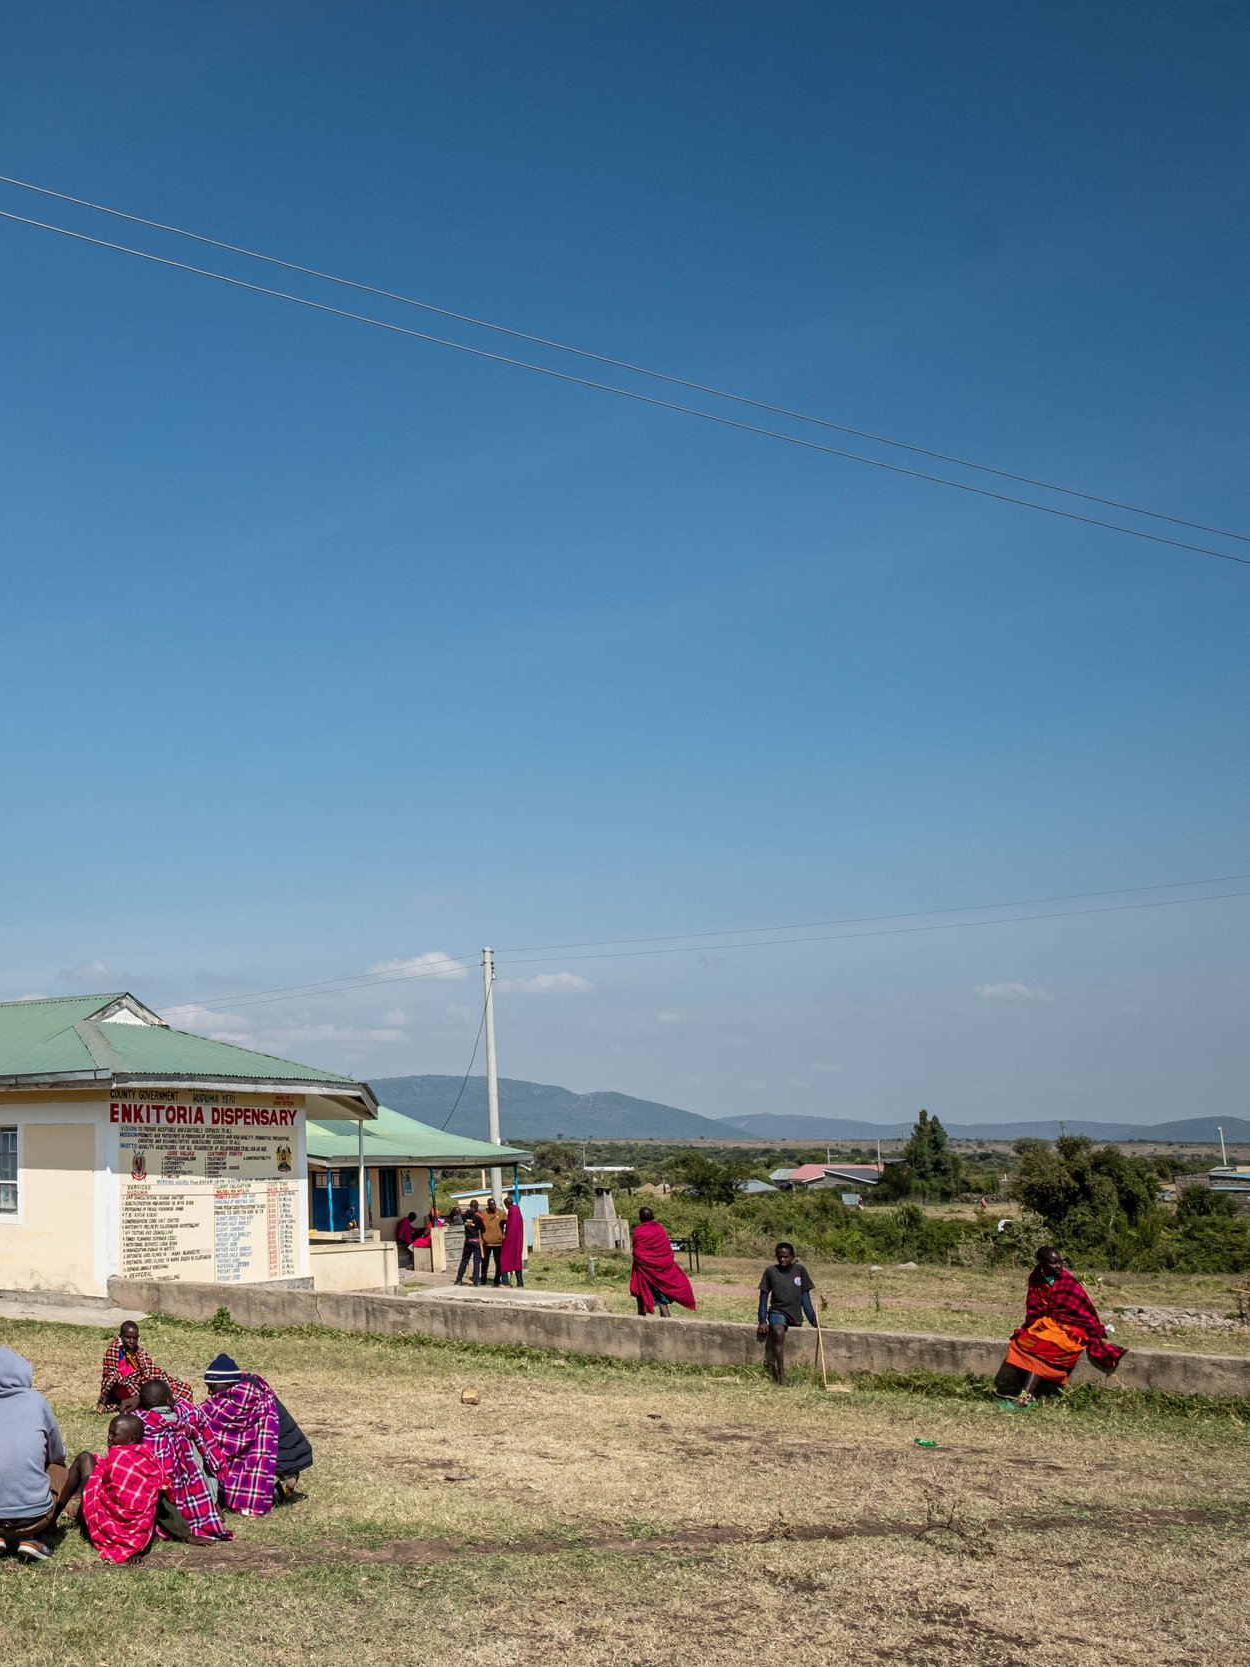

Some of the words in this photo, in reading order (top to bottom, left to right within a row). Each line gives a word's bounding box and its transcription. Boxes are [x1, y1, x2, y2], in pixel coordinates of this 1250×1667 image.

[110, 1089, 136, 1099] COUNTY
[138, 1090, 179, 1101] GOVERNMENT
[193, 1094, 219, 1103] HUDUMA
[222, 1094, 236, 1104] YETU
[110, 1103, 205, 1124] ENKITORIA
[211, 1107, 297, 1126] DISPENSARY
